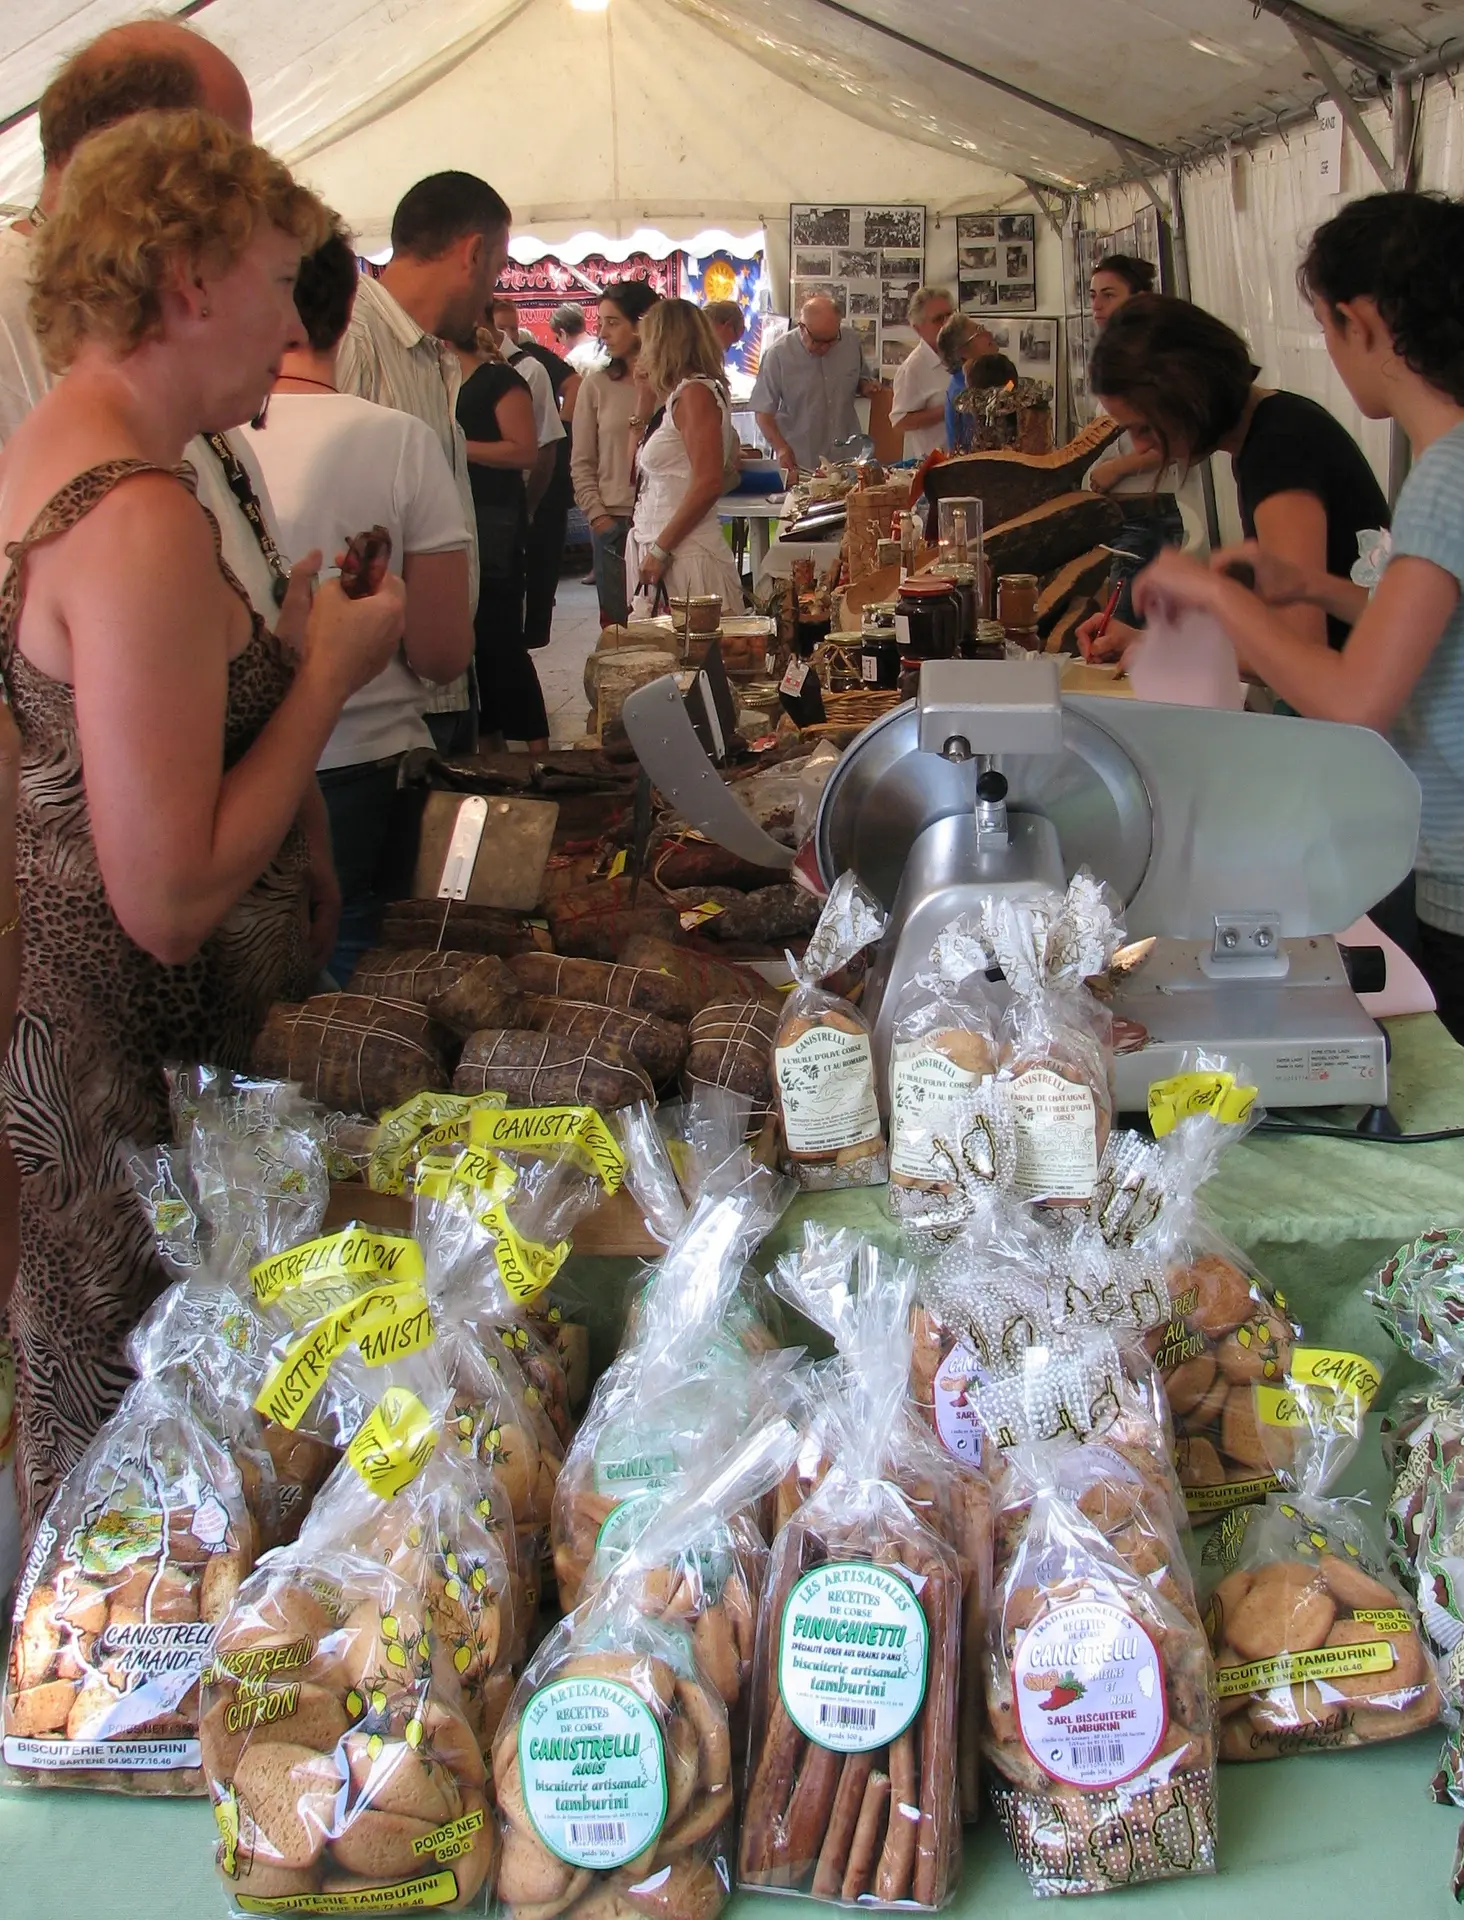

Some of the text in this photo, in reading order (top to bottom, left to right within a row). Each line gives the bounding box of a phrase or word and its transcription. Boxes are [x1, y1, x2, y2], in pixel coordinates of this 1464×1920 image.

[795, 1032, 846, 1055] CANISTRELLI
[842, 1044, 863, 1056] CORSE
[911, 1057, 956, 1079] CANISTRELLI
[1013, 1072, 1066, 1092] CANISTRELLI
[253, 1243, 334, 1298] NISTRELLI
[1164, 1320, 1186, 1346] AU
[1153, 1331, 1205, 1371] CITRON
[1185, 1482, 1262, 1500] BISCUITERIE
[799, 1569, 911, 1612] LES ARTISANALES
[827, 1591, 881, 1607] RECETTES
[829, 1605, 873, 1618] DE CORSE
[1356, 1611, 1395, 1621] POIDS
[793, 1614, 908, 1649] FINUCHIETTI
[1032, 1606, 1134, 1639] TRADITIONNELLES
[1063, 1619, 1107, 1633] RECETTES
[1376, 1621, 1398, 1631] 350
[823, 1646, 843, 1656] CORSE
[843, 1648, 856, 1657] AUX
[857, 1650, 880, 1660] GRAINS
[1030, 1636, 1139, 1668] CANISTRELLI
[793, 1656, 908, 1680] biscuiterie artisanale
[1216, 1647, 1377, 1683] ISCUITERIE TAMBURINI
[236, 1674, 268, 1702] AU
[810, 1676, 887, 1698] tamburini
[1104, 1682, 1117, 1693] ET
[1223, 1682, 1250, 1693] 20100
[225, 1682, 300, 1734] CITRON
[529, 1683, 641, 1726] LES ARTISANALES
[1110, 1693, 1134, 1706] NOIX
[556, 1705, 610, 1721] RECETTES
[1047, 1709, 1138, 1726] SARL BISCUITERIE
[560, 1722, 604, 1734] DE CORSE
[1066, 1722, 1121, 1735] TAMBURINI
[18, 1743, 188, 1756] BISCUITERIE TAMBURINI
[529, 1732, 641, 1761] CANISTRELLI
[572, 1761, 608, 1777] ANIS
[535, 1776, 648, 1792] biscuiterie artisanale
[555, 1793, 629, 1812] tamburini
[414, 1812, 484, 1854] POIDS NET
[437, 1843, 462, 1861] 350
[350, 1879, 440, 1904] TAMBURINI
